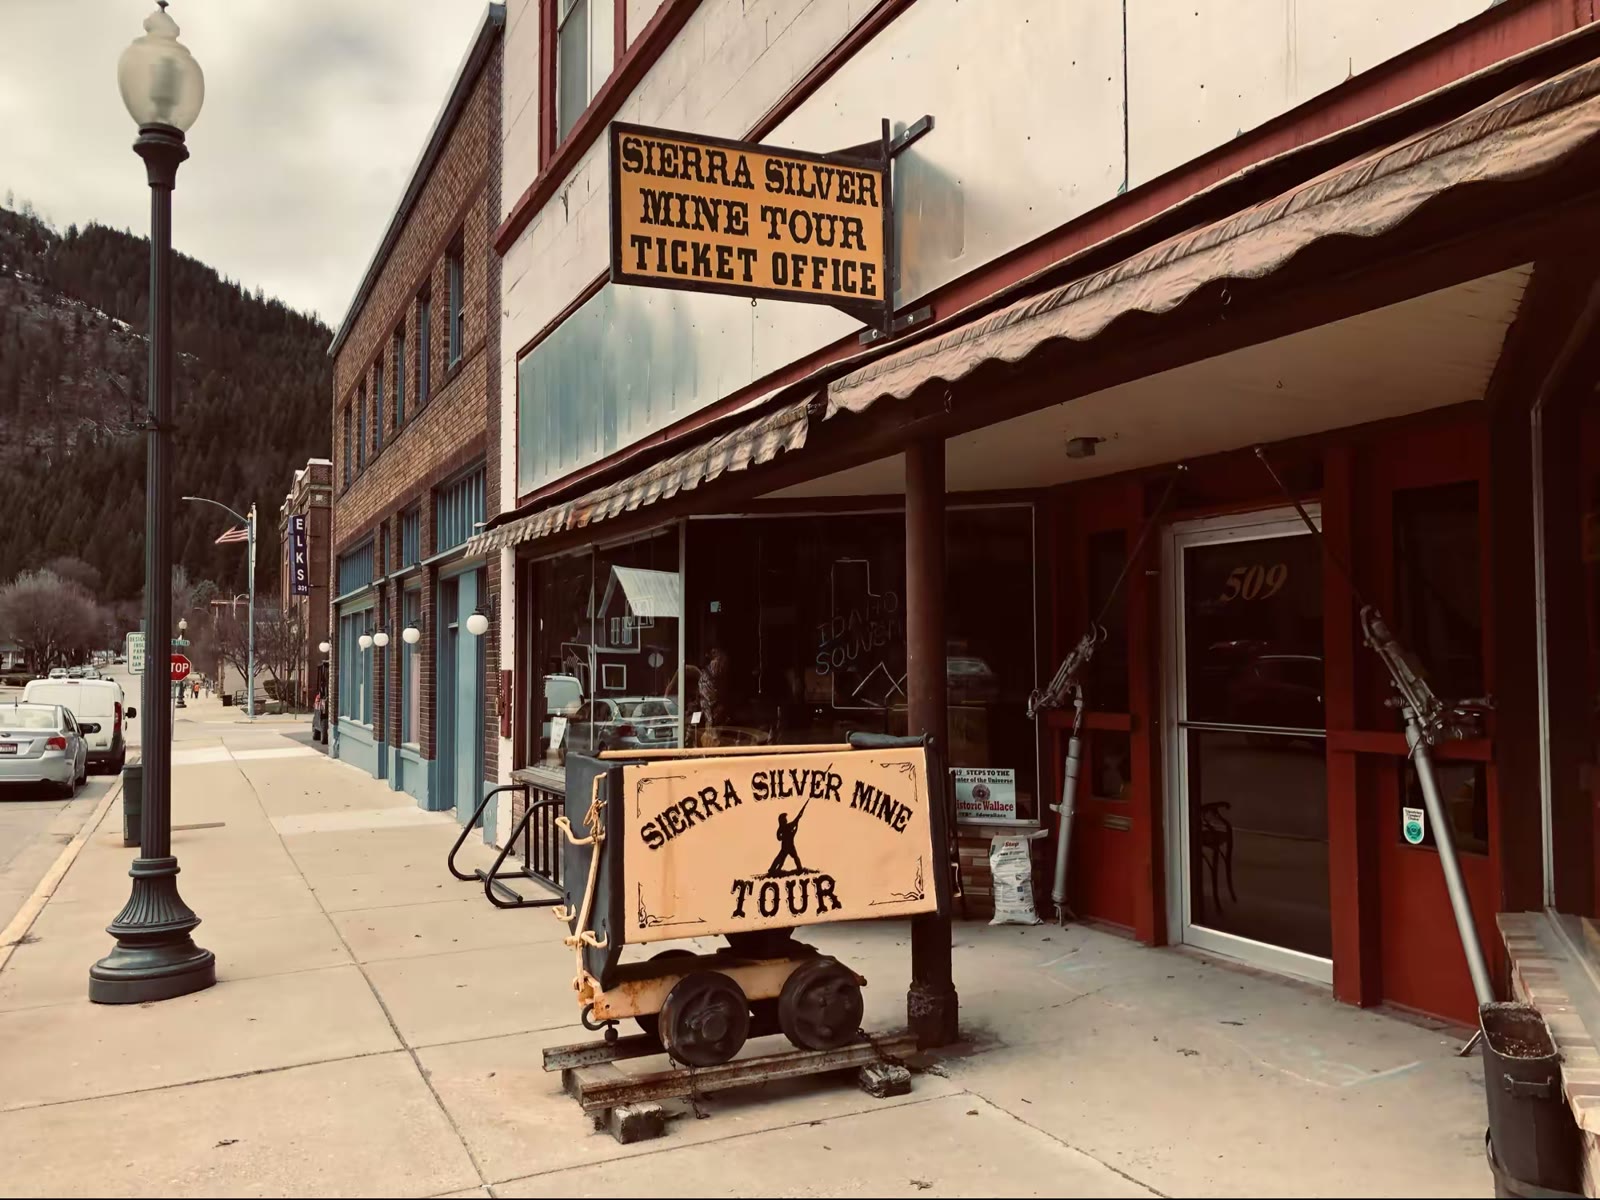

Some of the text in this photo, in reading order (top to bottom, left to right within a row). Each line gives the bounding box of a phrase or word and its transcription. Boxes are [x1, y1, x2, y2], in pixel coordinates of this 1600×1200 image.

[622, 136, 879, 207] SIERRA SILVER
[639, 188, 866, 250] MINE TOUR
[631, 234, 876, 296] TICKET OFFICE
[296, 518, 304, 581] ELKS
[1218, 563, 1288, 602] 509
[171, 662, 189, 673] TOP
[640, 767, 913, 850] SIERRA SILVER MINE
[956, 799, 1014, 811] istoric Wallace
[730, 874, 843, 919] TOUR
